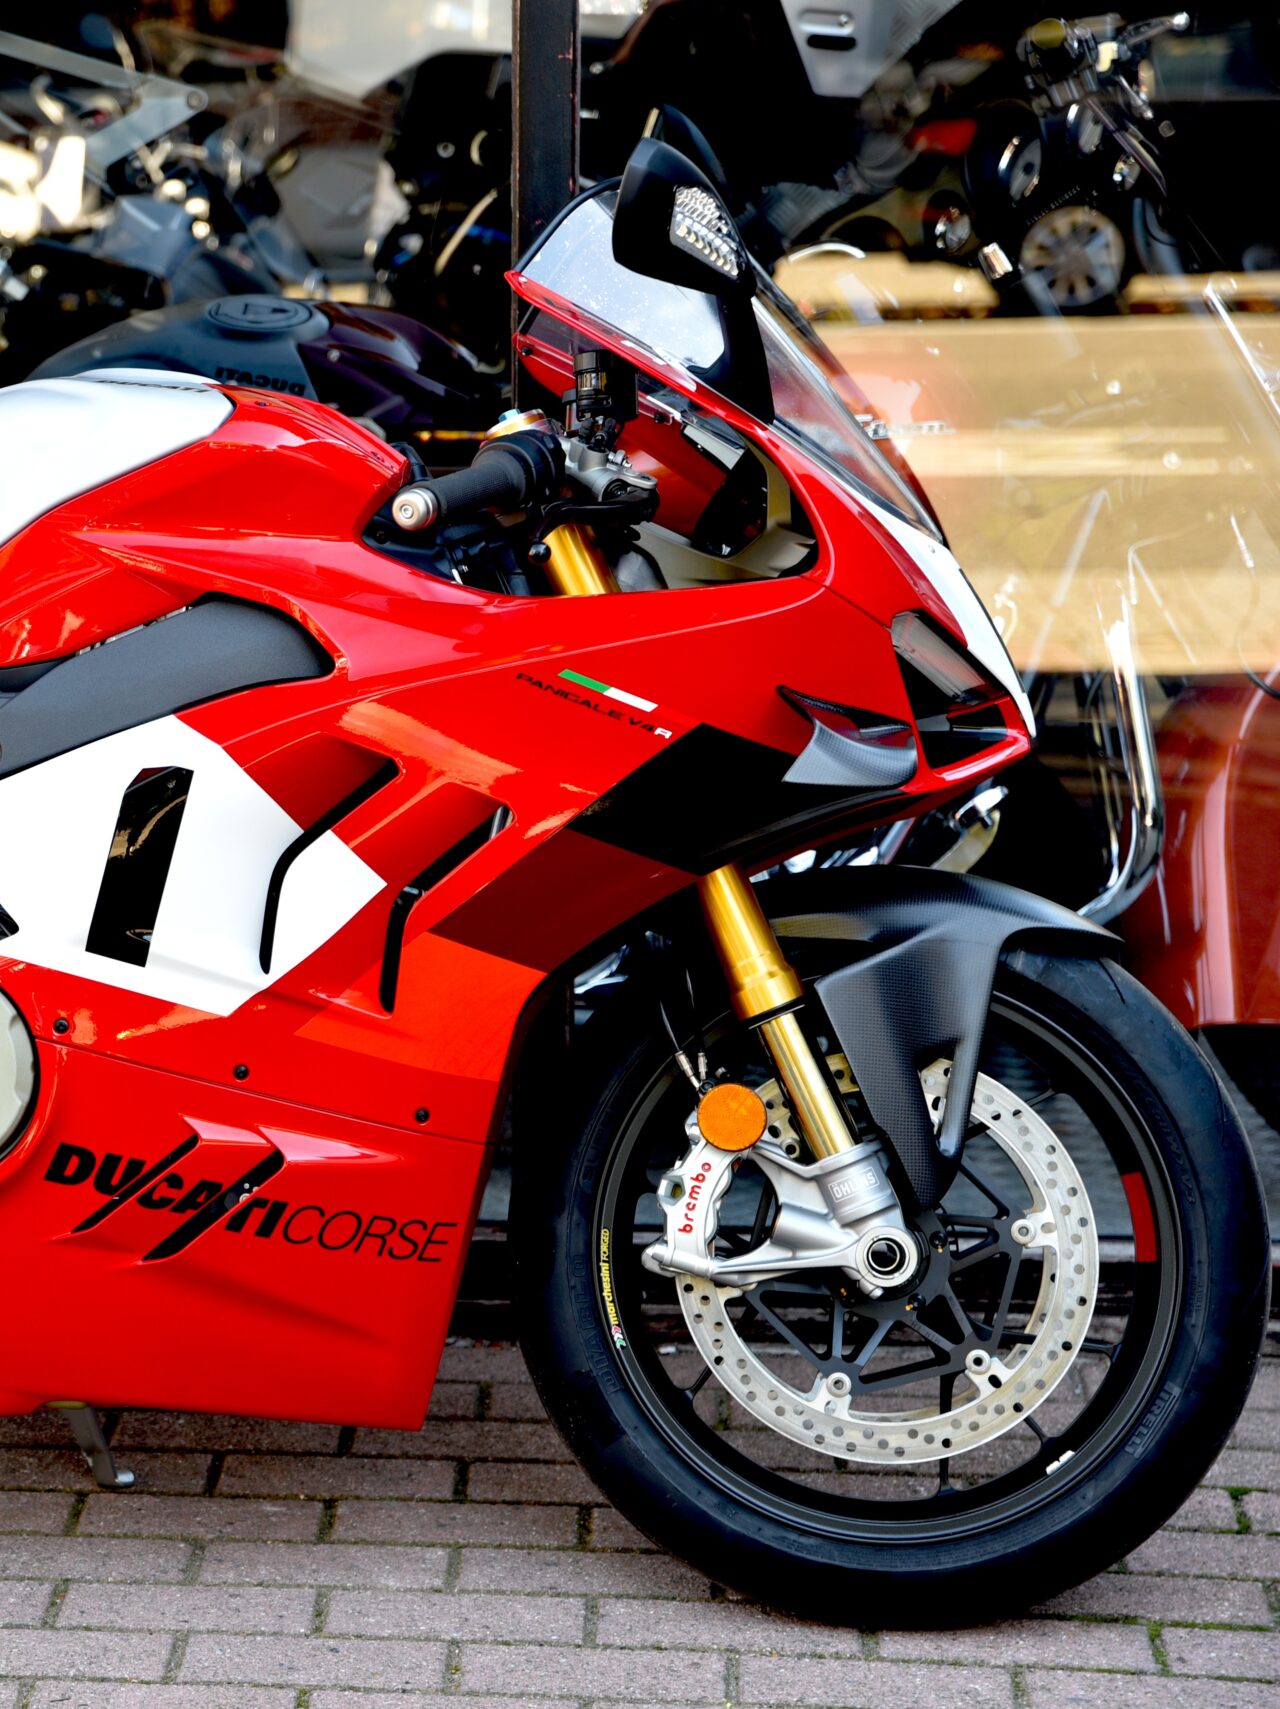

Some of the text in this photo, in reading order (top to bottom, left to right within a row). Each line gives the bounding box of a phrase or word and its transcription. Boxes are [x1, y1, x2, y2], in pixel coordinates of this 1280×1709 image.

[516, 672, 625, 720] PANIGALE
[43, 1142, 458, 1263] DUCATI CORSE
[678, 1161, 713, 1235] brembo
[599, 1228, 619, 1325] marchesini FORGED
[1121, 1378, 1183, 1460] PIRELLI
